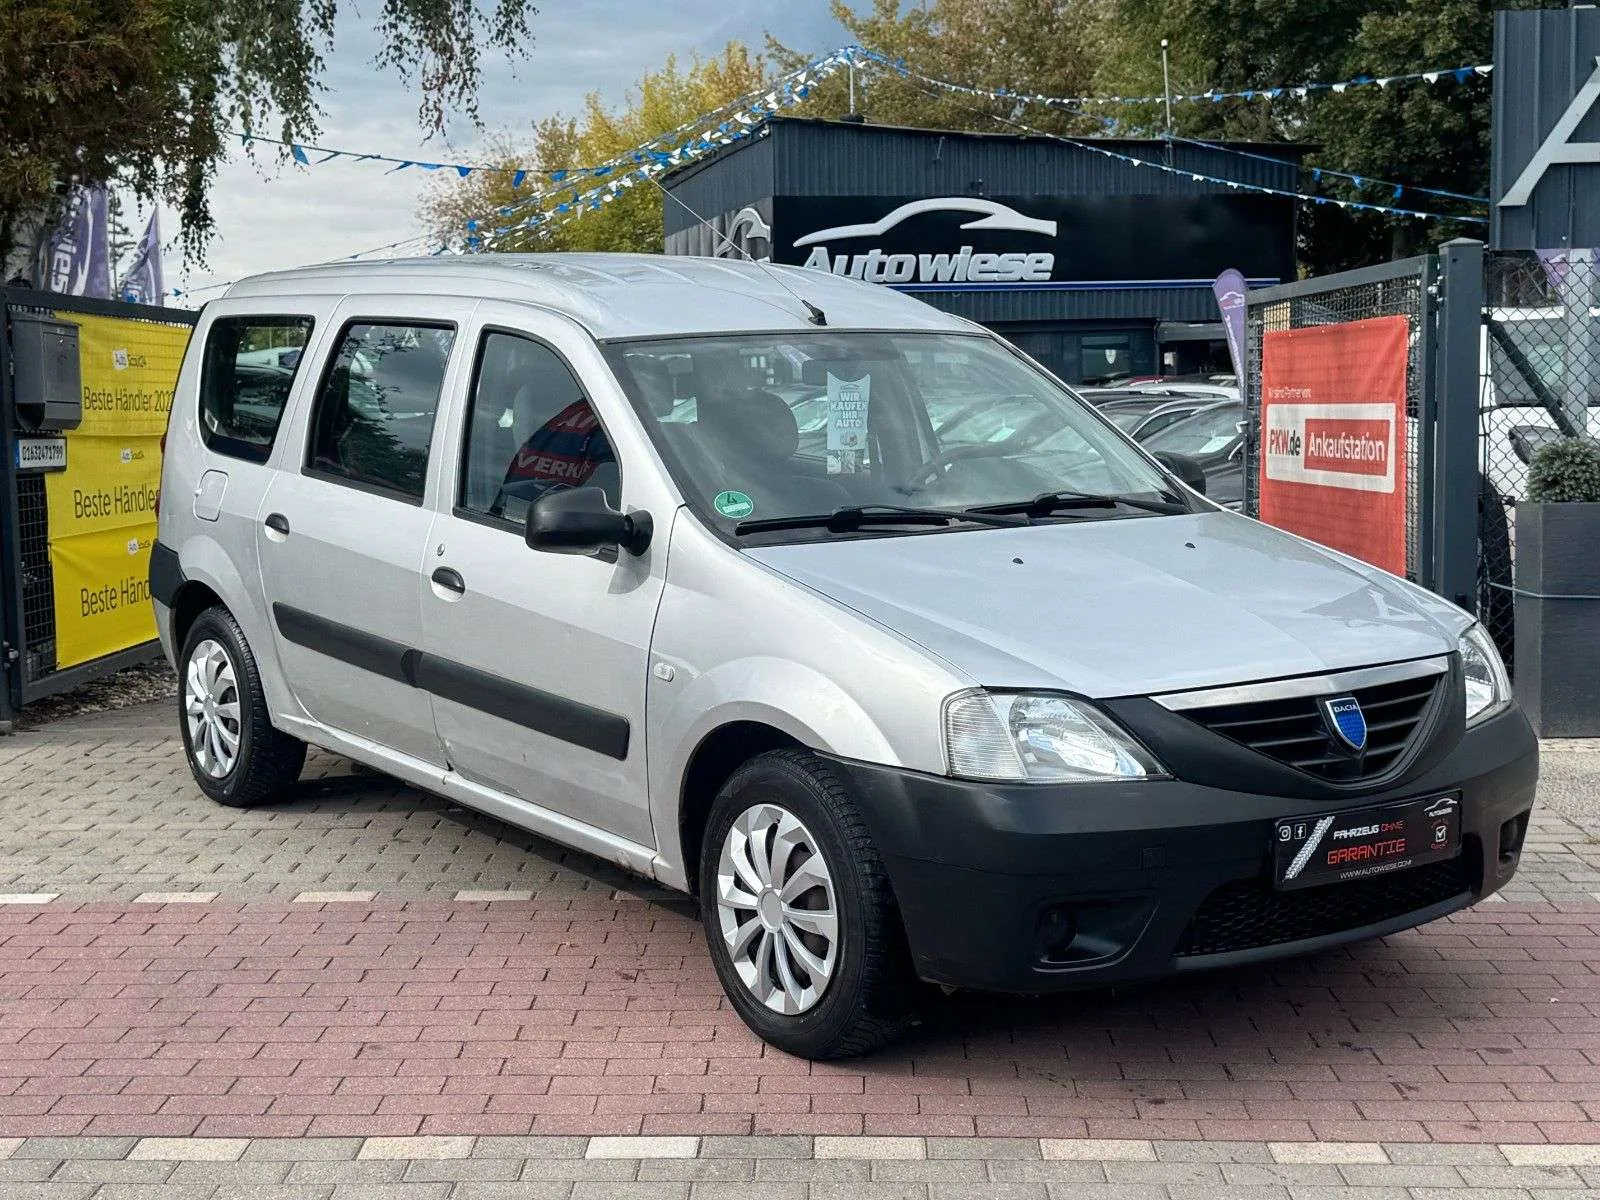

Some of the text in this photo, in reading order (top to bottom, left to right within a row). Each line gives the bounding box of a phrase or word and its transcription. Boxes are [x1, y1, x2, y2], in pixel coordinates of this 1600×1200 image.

[83, 386, 113, 411] Beste
[115, 387, 153, 412] Händler
[840, 391, 860, 402] WIR
[836, 419, 862, 428] AUTO
[1308, 432, 1385, 461] Ankaufstation
[74, 489, 111, 518] Beste
[80, 584, 118, 617] Beste
[1333, 704, 1358, 713] DACIA
[1333, 824, 1380, 841] FAHRZEUG
[1327, 838, 1406, 865] GARANTIE
